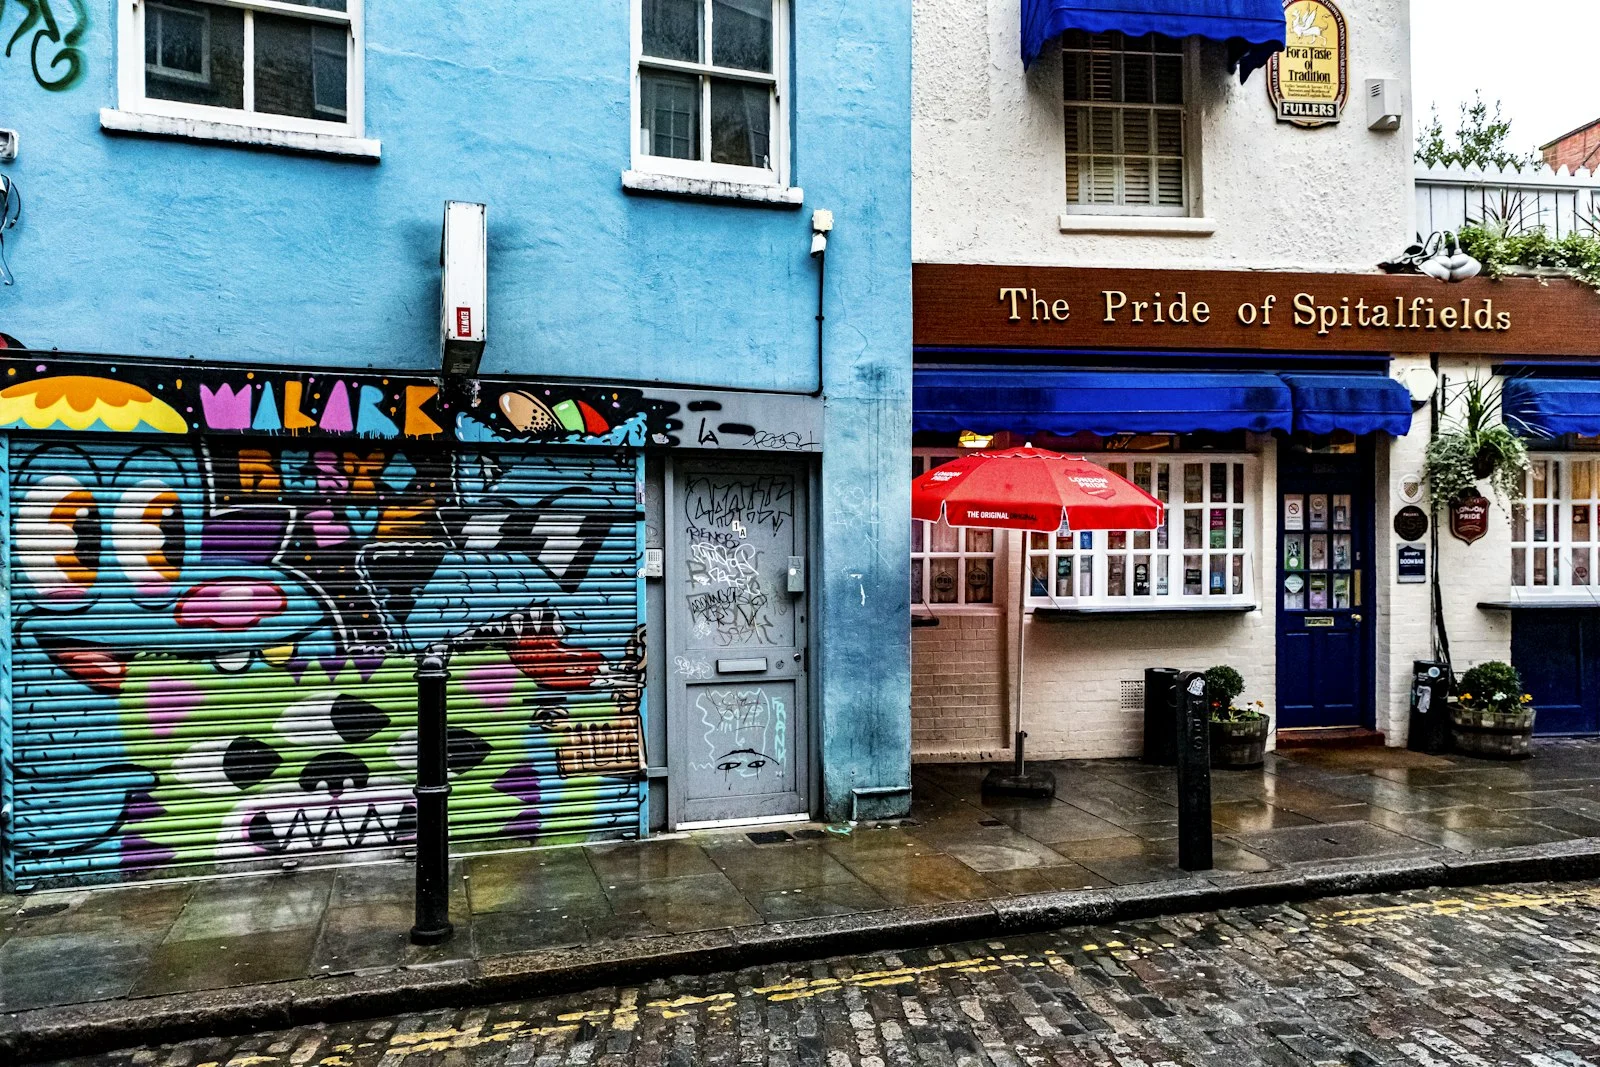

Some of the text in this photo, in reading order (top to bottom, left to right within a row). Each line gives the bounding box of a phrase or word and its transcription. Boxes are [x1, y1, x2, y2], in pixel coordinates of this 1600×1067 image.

[1286, 47, 1332, 60] For a Taste
[1304, 60, 1313, 70] of
[1288, 70, 1331, 83] Tradition
[1283, 103, 1335, 116] FULLERS
[1000, 287, 1512, 335] The Pride of Spitalfields
[460, 310, 470, 334] EDWIN
[1067, 476, 1109, 484] LONDON
[1079, 481, 1109, 489] PRIDE
[980, 511, 1009, 520] ORIGINAL
